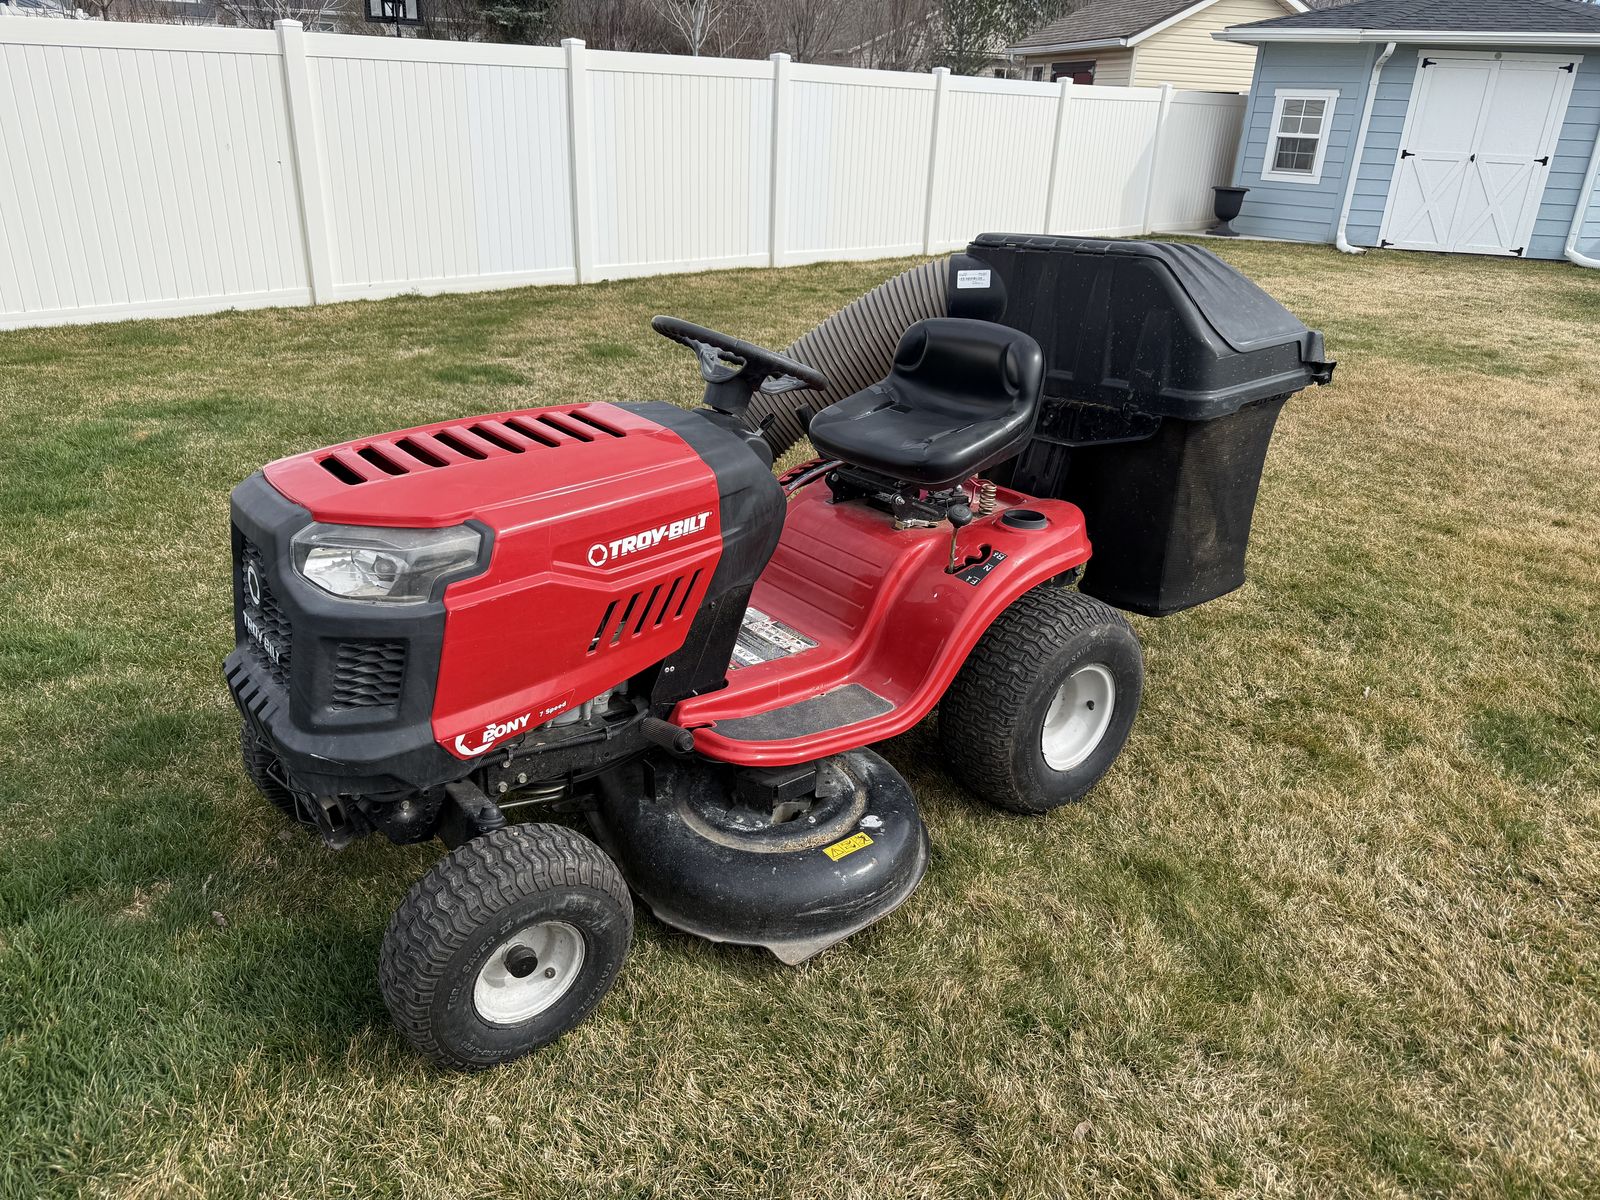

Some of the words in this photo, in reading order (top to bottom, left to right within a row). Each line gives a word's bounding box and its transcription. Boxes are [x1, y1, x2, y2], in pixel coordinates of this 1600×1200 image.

[609, 511, 712, 559] TROY-BILT
[983, 563, 993, 571] N
[482, 713, 531, 744] PONY
[539, 710, 544, 718] 7
[545, 700, 567, 715] Speed
